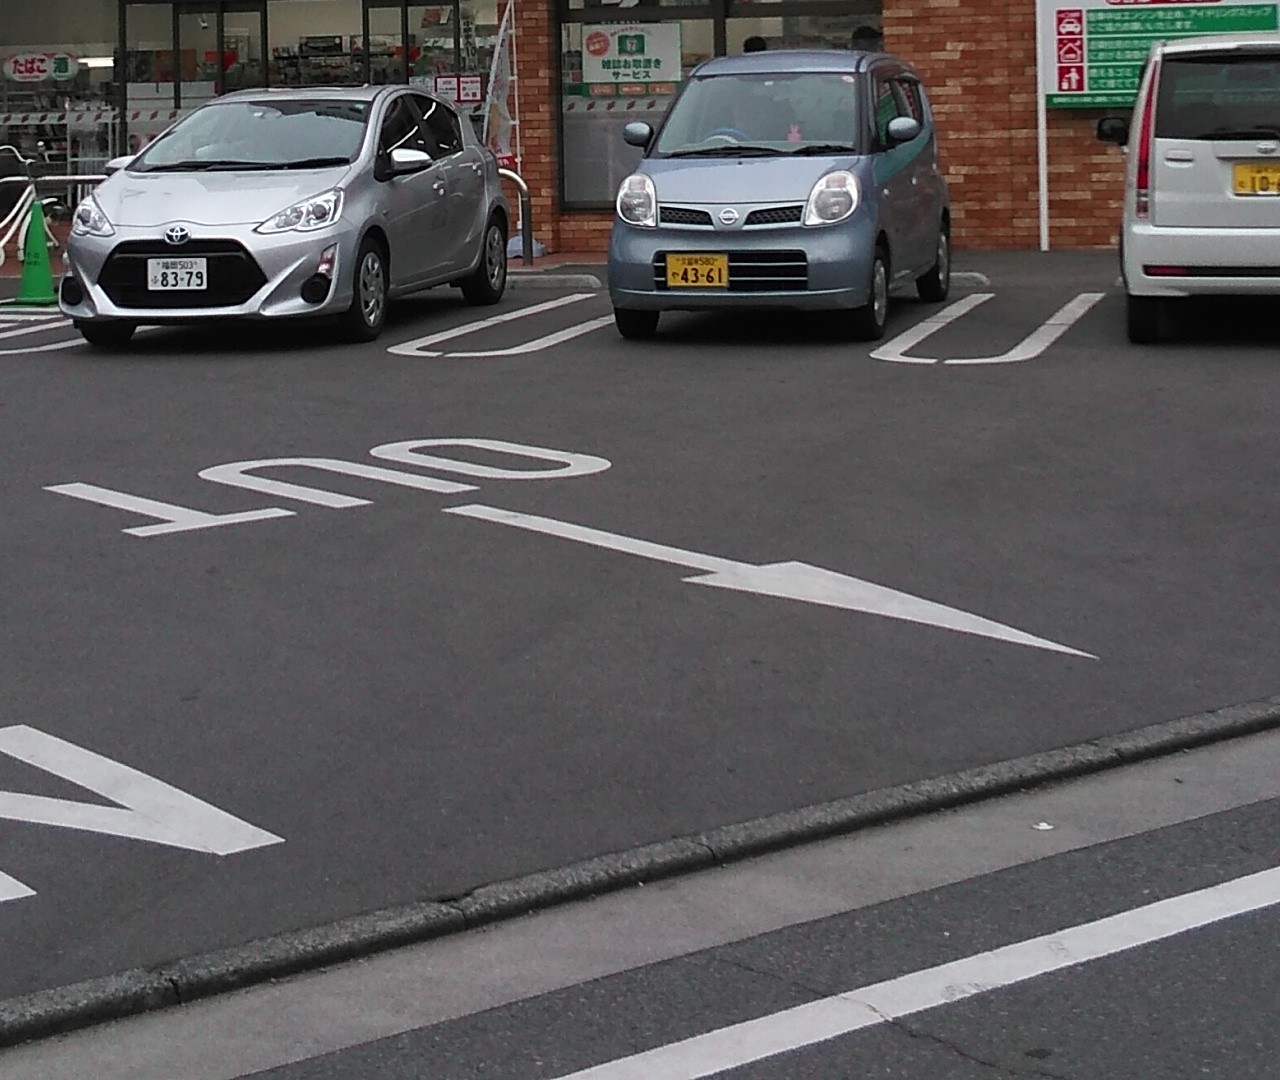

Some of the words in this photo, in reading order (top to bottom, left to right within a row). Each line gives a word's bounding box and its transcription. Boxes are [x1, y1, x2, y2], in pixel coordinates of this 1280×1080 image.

[12, 57, 47, 75] たばこ
[612, 70, 651, 80] サービス
[160, 271, 204, 288] 83-79
[680, 267, 722, 284] 43-61
[43, 436, 611, 538] OUT
